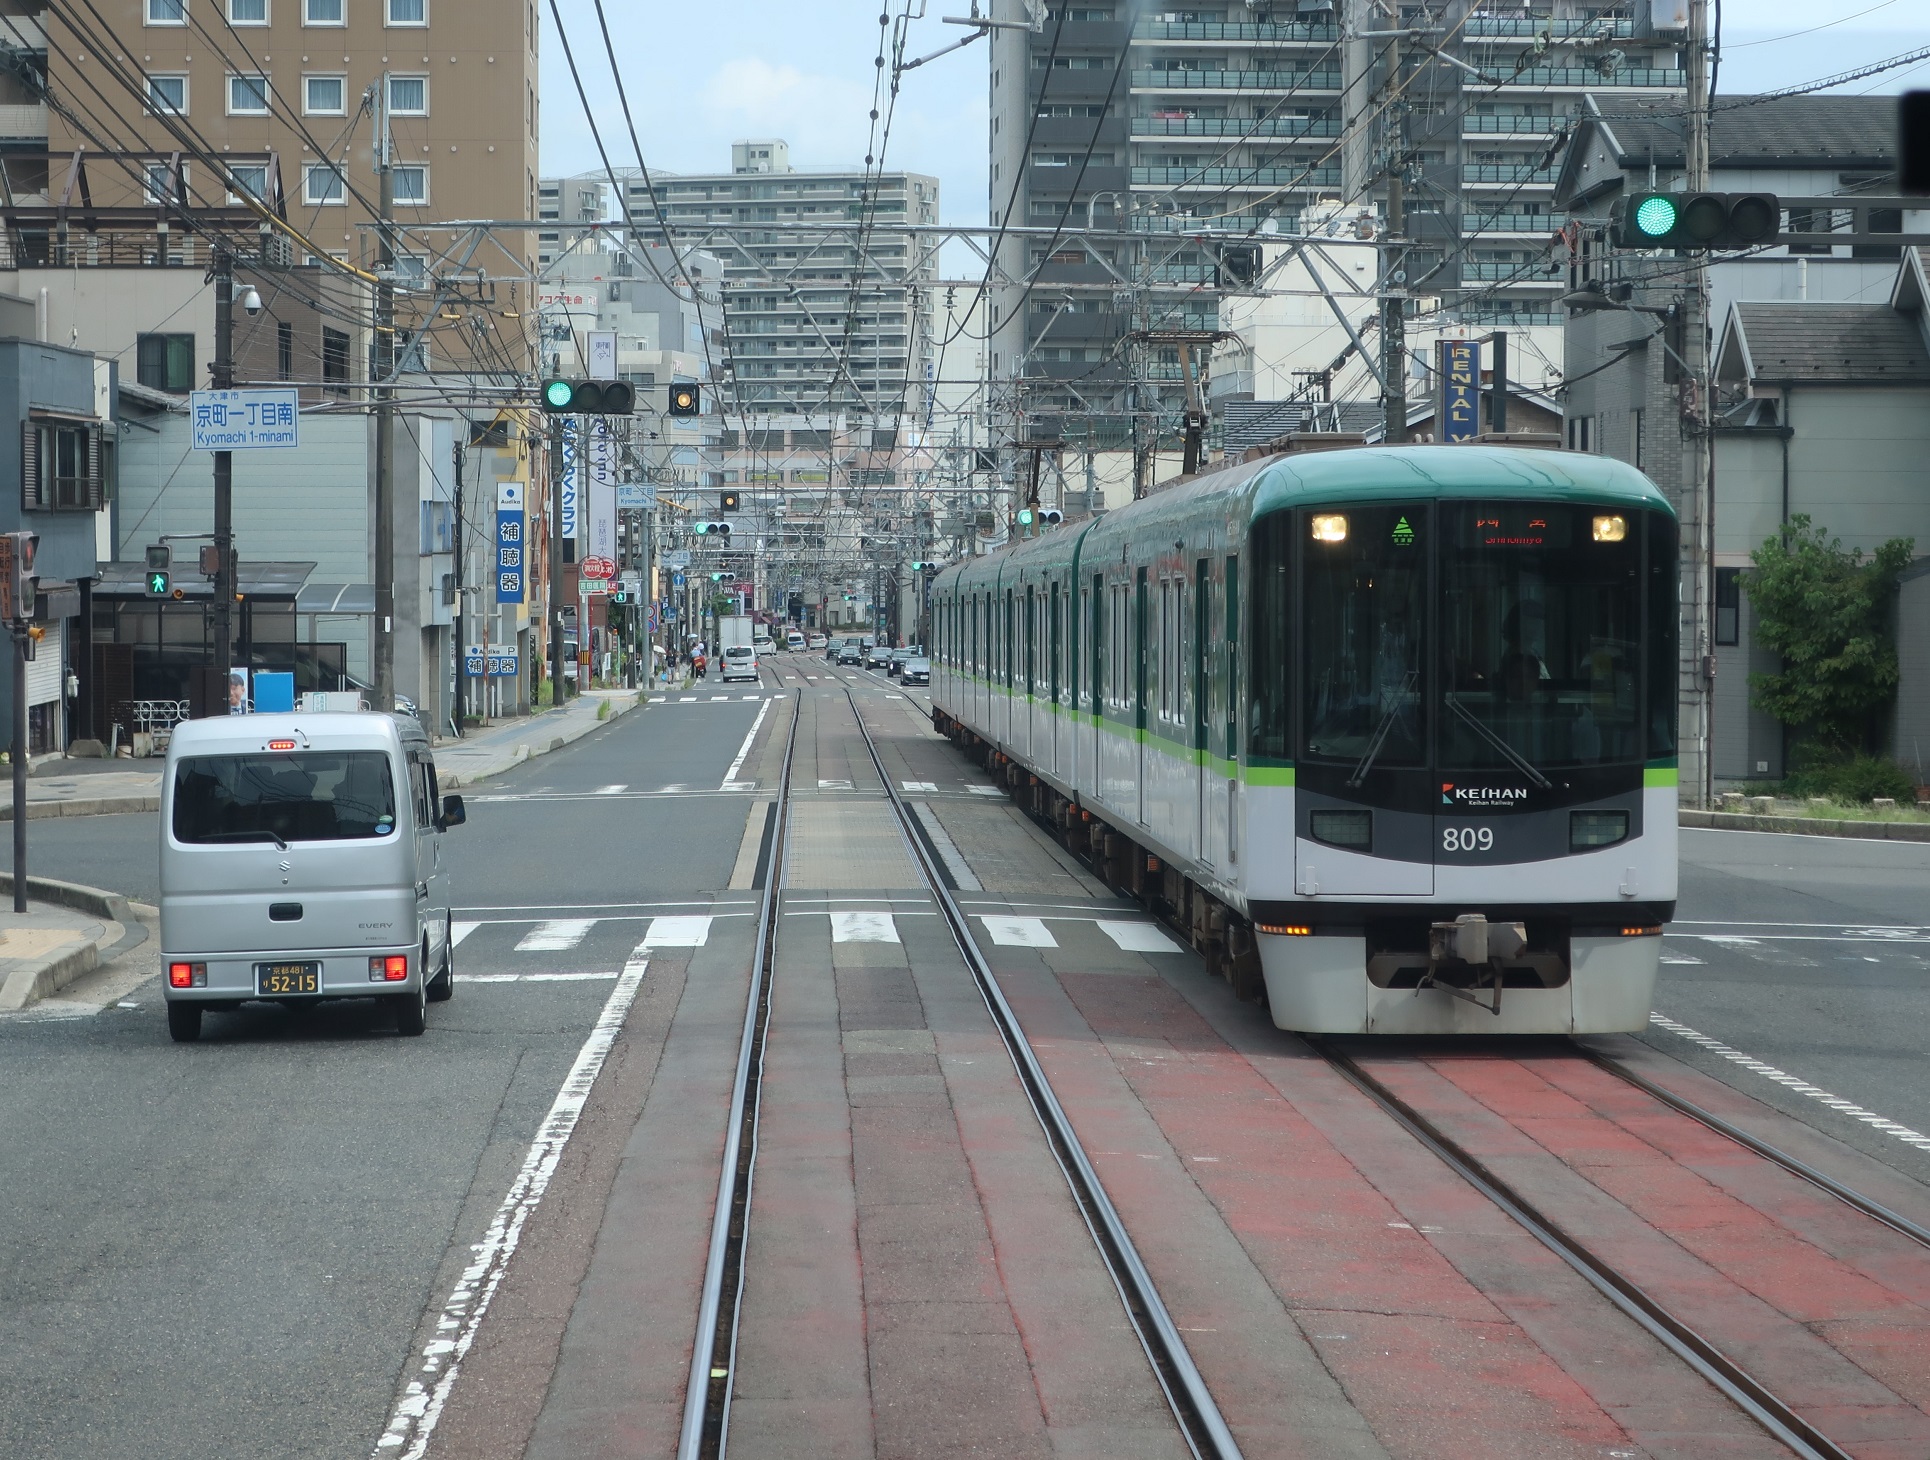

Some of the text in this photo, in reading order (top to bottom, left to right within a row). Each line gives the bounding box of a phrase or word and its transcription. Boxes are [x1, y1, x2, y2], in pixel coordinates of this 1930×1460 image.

[1450, 348, 1472, 421] RENTAL
[209, 392, 239, 400] 大津市
[196, 402, 293, 427] 京町一丁目南
[197, 429, 294, 446] Kyomachi 1-minami
[618, 488, 654, 496] 京町一丁目
[598, 519, 607, 555] 琵琶湖大
[500, 522, 520, 592] 補聴器
[508, 647, 515, 655] P
[1456, 788, 1527, 799] KEIHAN
[1443, 827, 1494, 852] 809
[271, 975, 315, 992] 52-15
